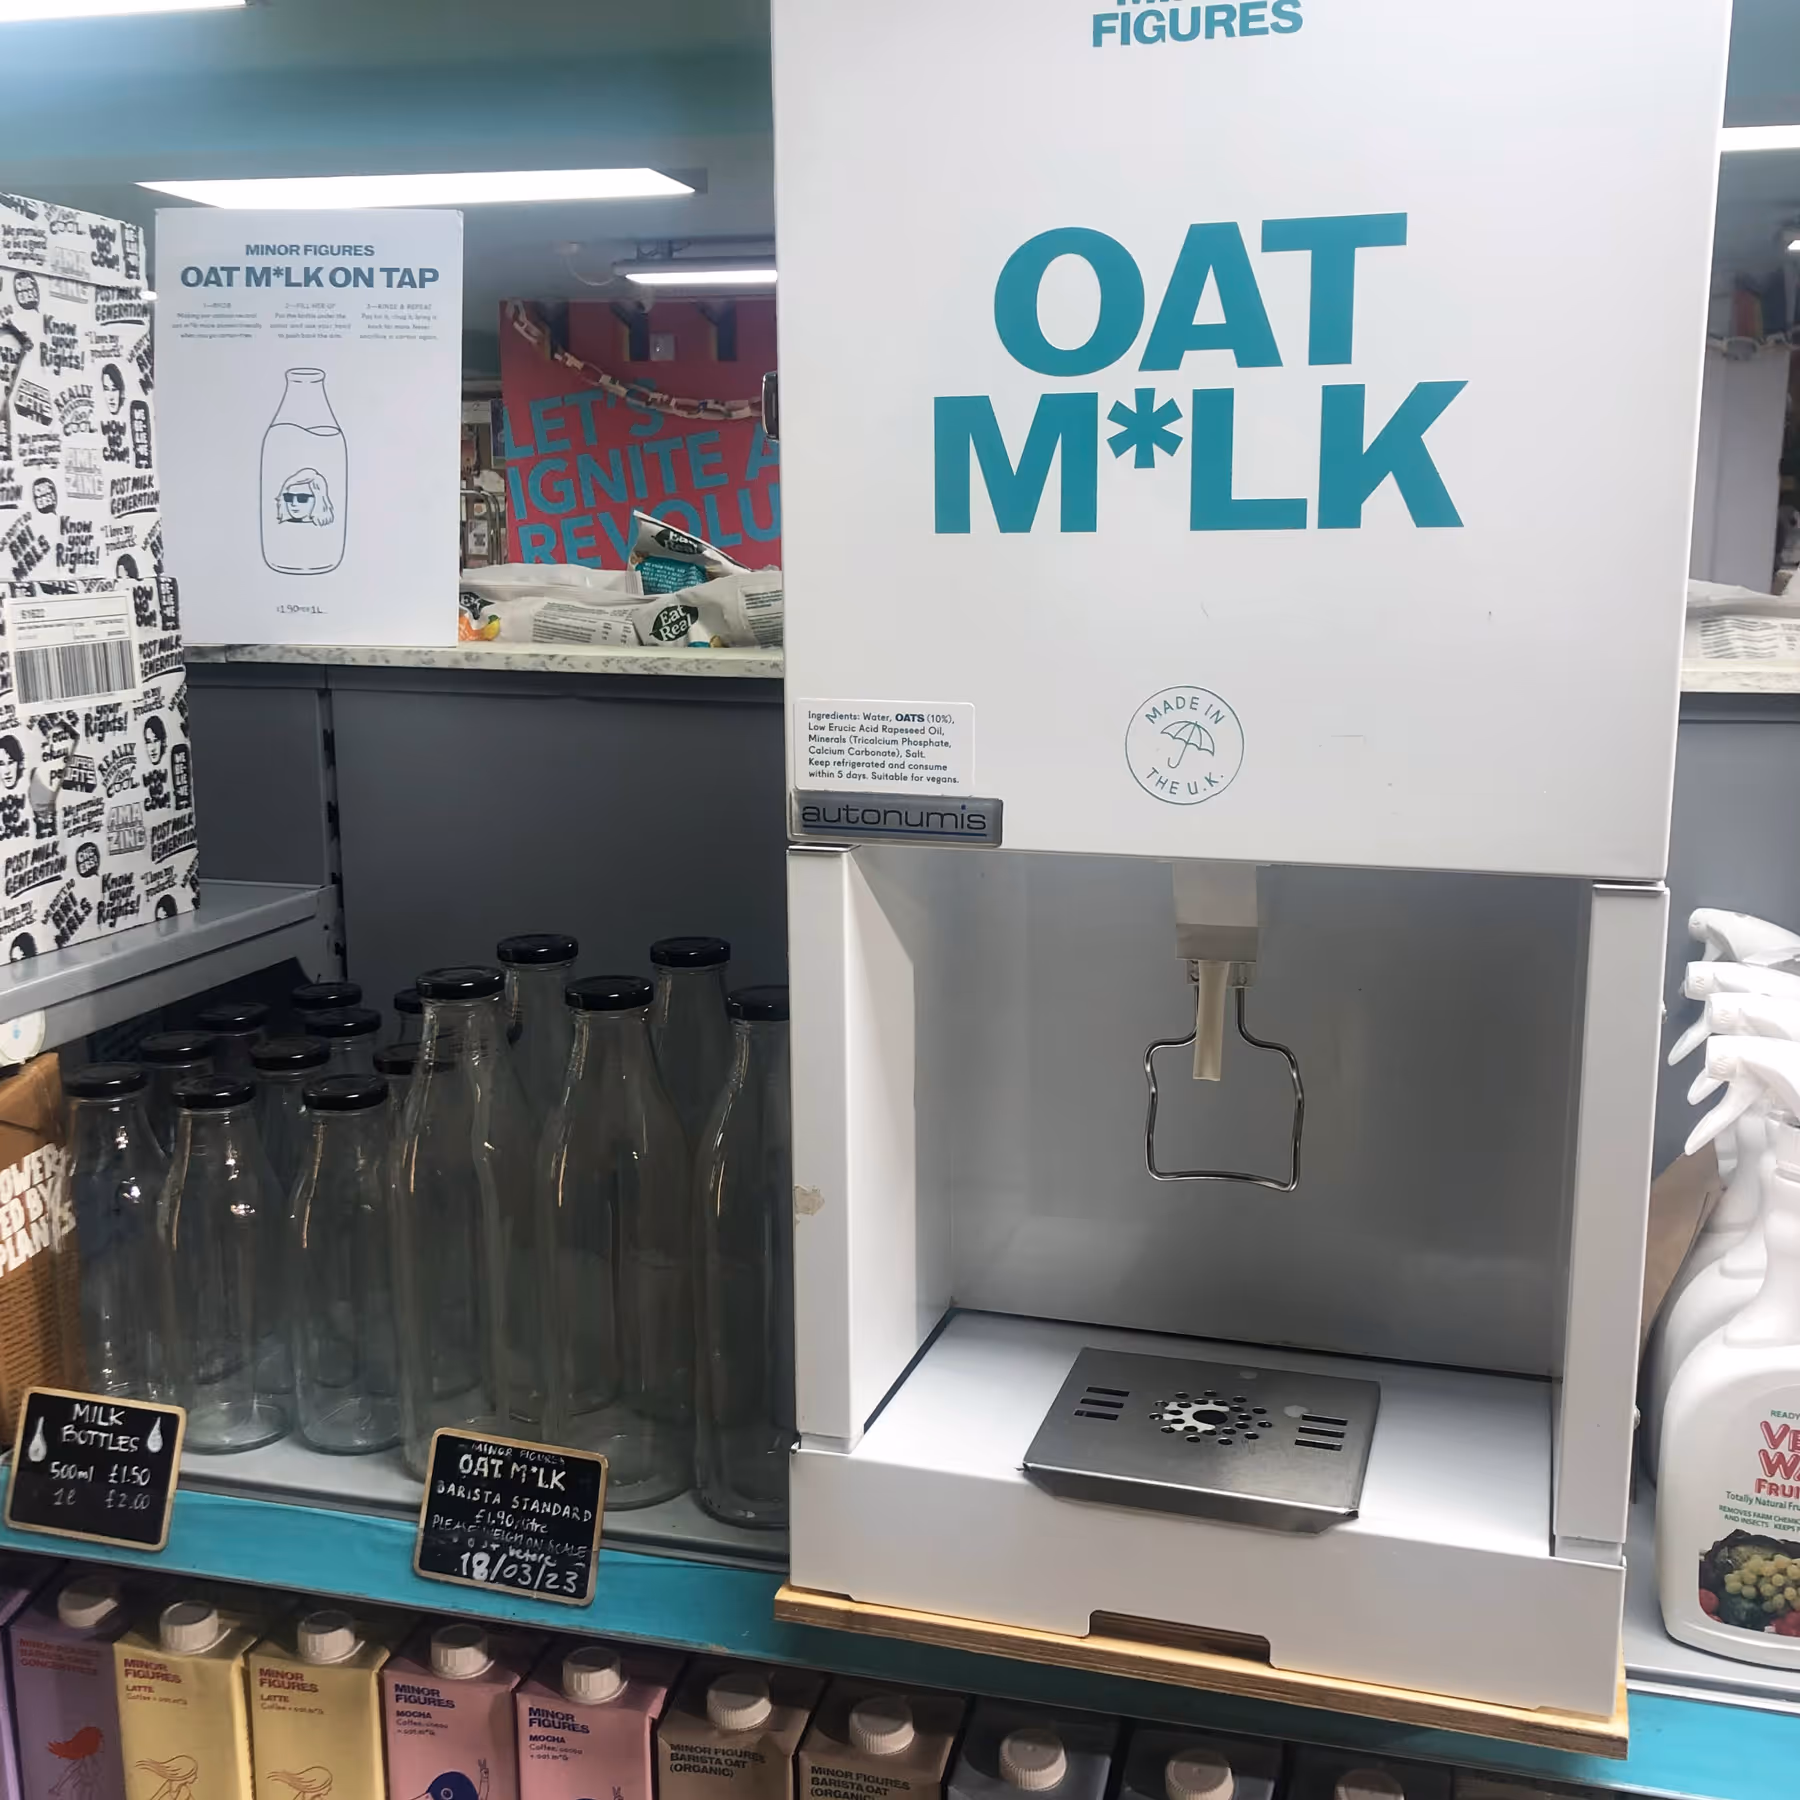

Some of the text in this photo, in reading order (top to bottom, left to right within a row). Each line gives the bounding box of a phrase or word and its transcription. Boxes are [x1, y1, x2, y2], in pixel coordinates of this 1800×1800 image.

[1092, 0, 1303, 48] FIGURES
[245, 244, 375, 257] MINOR FIGURES
[181, 266, 240, 288] OAT
[328, 266, 374, 288] ON
[379, 267, 439, 289] TAP
[994, 212, 1408, 377] OAT
[43, 314, 77, 336] Know
[110, 474, 155, 498] POST MILK
[507, 431, 729, 520] IGNITE
[110, 490, 160, 516] GENERATION
[60, 515, 92, 536] Know
[67, 535, 94, 552] your
[56, 543, 100, 574] Rights!
[660, 605, 687, 626] Eat
[659, 613, 692, 642] Real
[159, 634, 182, 652] MILK
[808, 710, 955, 725] Ingredients: Water, OATS (10%),
[1145, 696, 1225, 724] MADE IN
[85, 711, 128, 743] Rights!
[808, 723, 945, 736] Low Erucic Acid Rapeseed Oil,
[808, 735, 952, 749] Minerals (Tricalcium Phosphate,
[808, 746, 926, 759] Calcium Carbonate), Salt.
[98, 742, 137, 778] REALLY
[808, 758, 947, 772] Keep refrigerated and consume
[808, 770, 960, 785] within 5 days. Suitable for vegans.
[1146, 767, 1224, 796] THE U.K.
[802, 804, 987, 831] autonumis
[152, 812, 195, 845] POST MILK
[5, 841, 60, 878] POST MILK
[5, 855, 67, 896] GENERATION
[102, 872, 134, 893] Know
[97, 893, 141, 928] Rights!
[72, 1403, 125, 1426] MILK
[61, 1424, 140, 1452] BOTTLES
[471, 1443, 513, 1457] MINOR
[50, 1461, 94, 1483] 500ml
[459, 1453, 503, 1478] OAT
[436, 1480, 592, 1522] BARISTA STANDARD
[1726, 1491, 1754, 1505] Totally
[1755, 1497, 1787, 1509] Natural
[1719, 1505, 1752, 1518] REMOVES
[1753, 1511, 1773, 1521] FARM
[1724, 1514, 1740, 1523] AND
[1741, 1518, 1769, 1528] INSECTS
[460, 1550, 579, 1593] 18/03/23
[124, 1659, 168, 1671] MINOR
[259, 1668, 304, 1681] MINOR
[125, 1669, 182, 1683] FIGURES
[259, 1678, 319, 1692] FIGURES
[395, 1683, 440, 1697] MINOR
[395, 1694, 455, 1708] FIGURES
[396, 1710, 432, 1719] MOCHA
[529, 1707, 575, 1722] MINOR
[529, 1718, 590, 1734] FIGURES
[529, 1735, 566, 1743] MOCHA
[670, 1744, 766, 1763] MINOR FIGURES
[670, 1753, 748, 1768] BARISTA OAT
[670, 1763, 734, 1777] (ORGANIC)
[811, 1766, 911, 1790] MINOR FIGURES
[811, 1777, 890, 1796] BARISTA OAT
